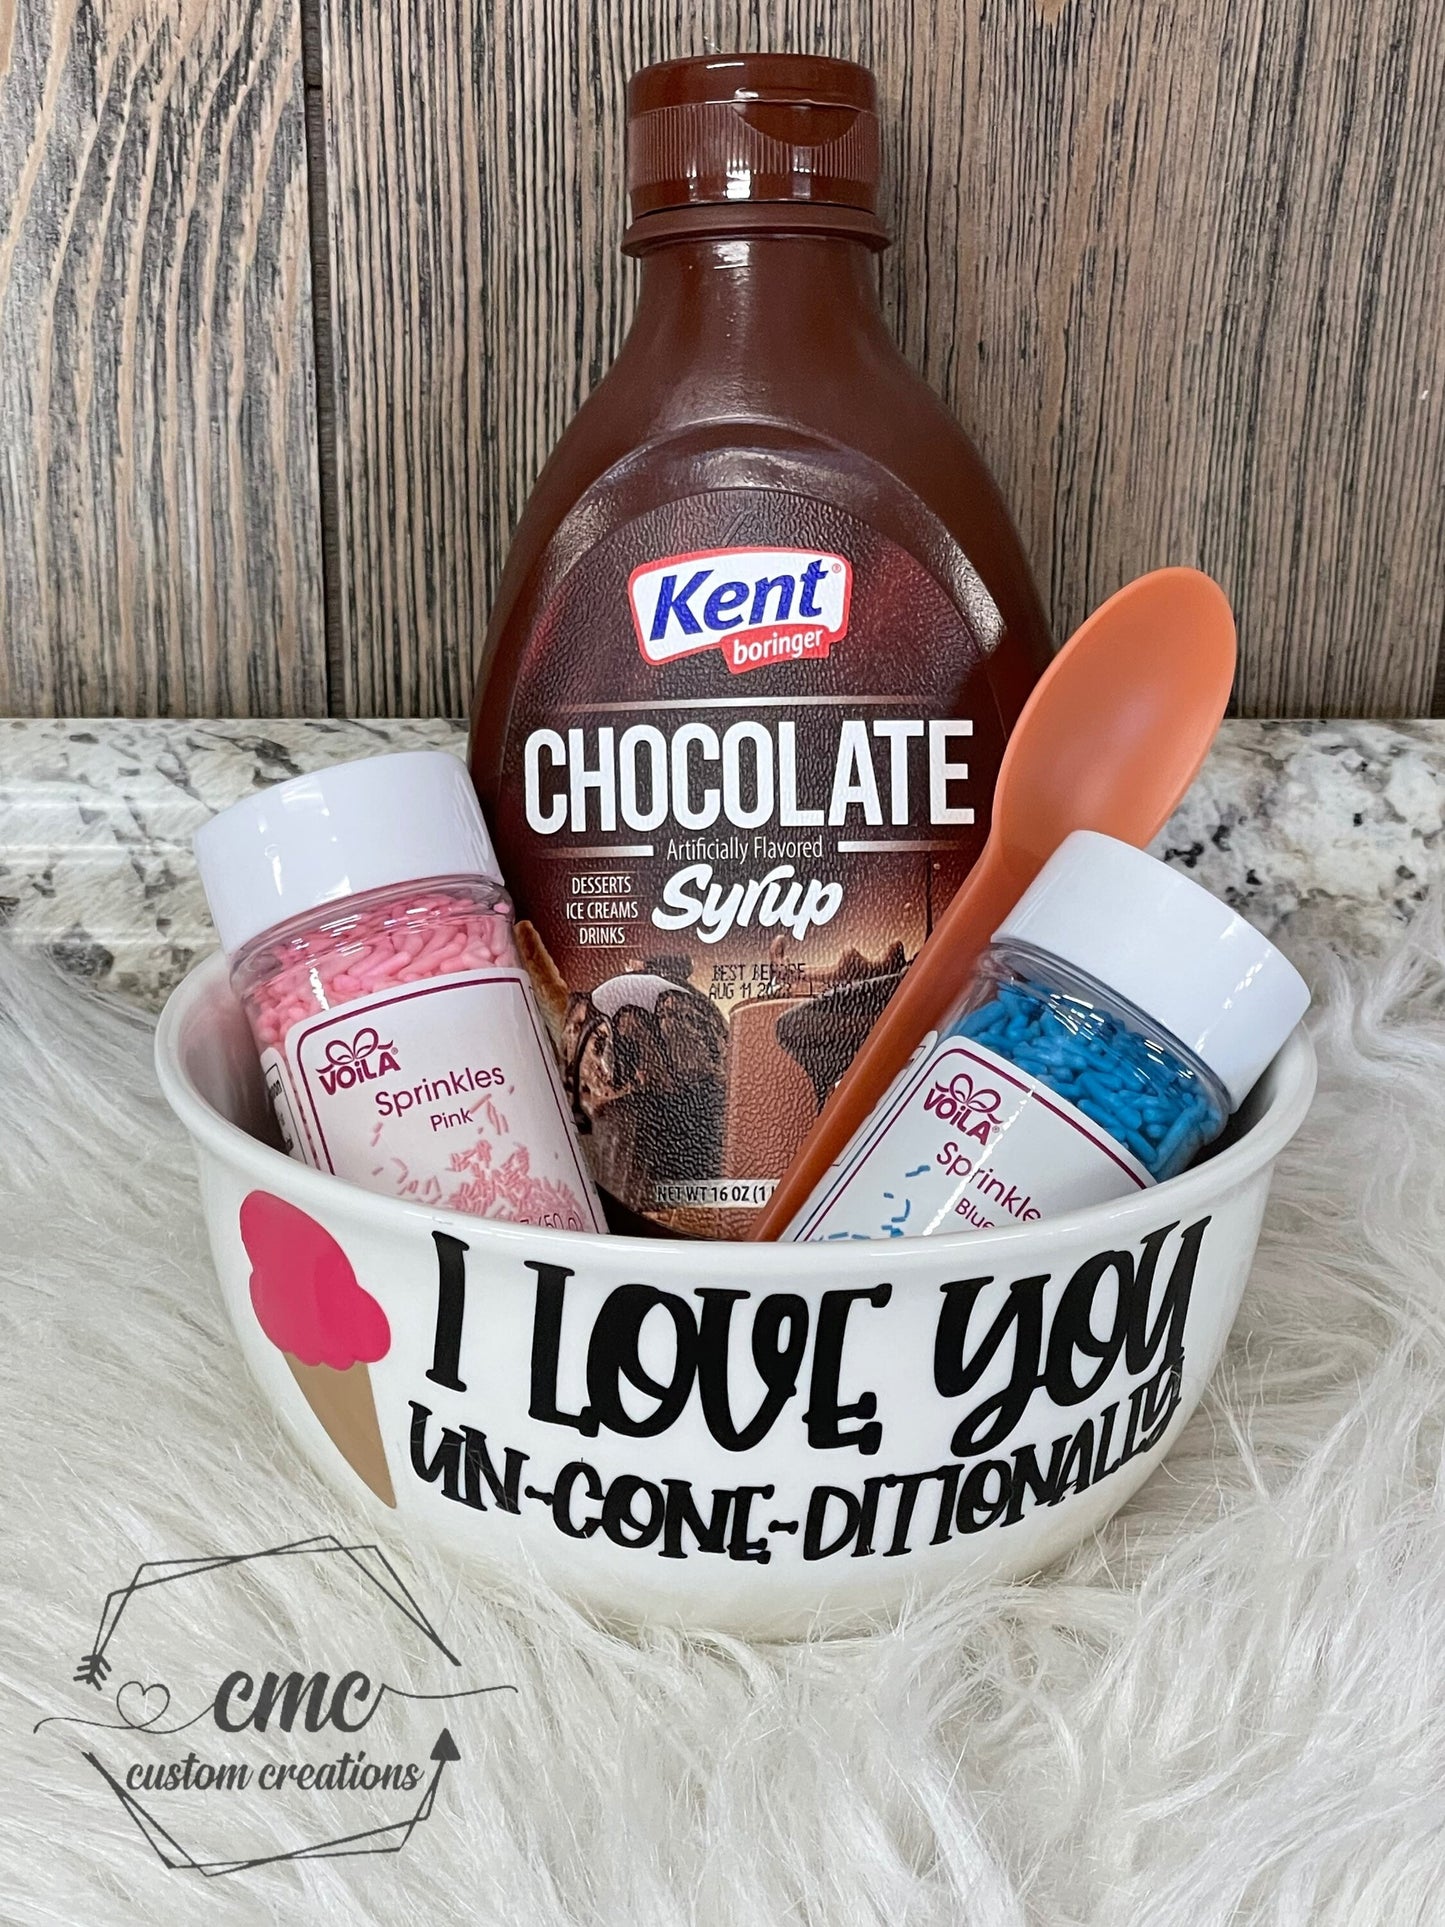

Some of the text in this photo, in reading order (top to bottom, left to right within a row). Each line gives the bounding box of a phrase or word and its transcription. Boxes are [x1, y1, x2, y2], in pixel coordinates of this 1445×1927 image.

[649, 558, 829, 642] Kent
[732, 629, 824, 666] boringer
[523, 719, 975, 836] CHOCOLATE
[666, 836, 824, 864] Artificially Flavored
[571, 876, 632, 895] DESSERTS
[565, 901, 639, 920] ICE CREAMS
[651, 863, 844, 944] Syrup
[579, 927, 626, 946] DRINKS
[711, 964, 746, 982] BEST
[708, 982, 735, 1000] AUG
[374, 1065, 506, 1118] Sprinkles
[429, 1107, 474, 1132] Pink
[657, 1186, 682, 1202] NET
[685, 1186, 707, 1202] WT
[711, 1186, 728, 1201] 16
[732, 1185, 750, 1201] OZ
[935, 1142, 1042, 1222] Sprinkle
[425, 1215, 1212, 1457] I LOVE YOU
